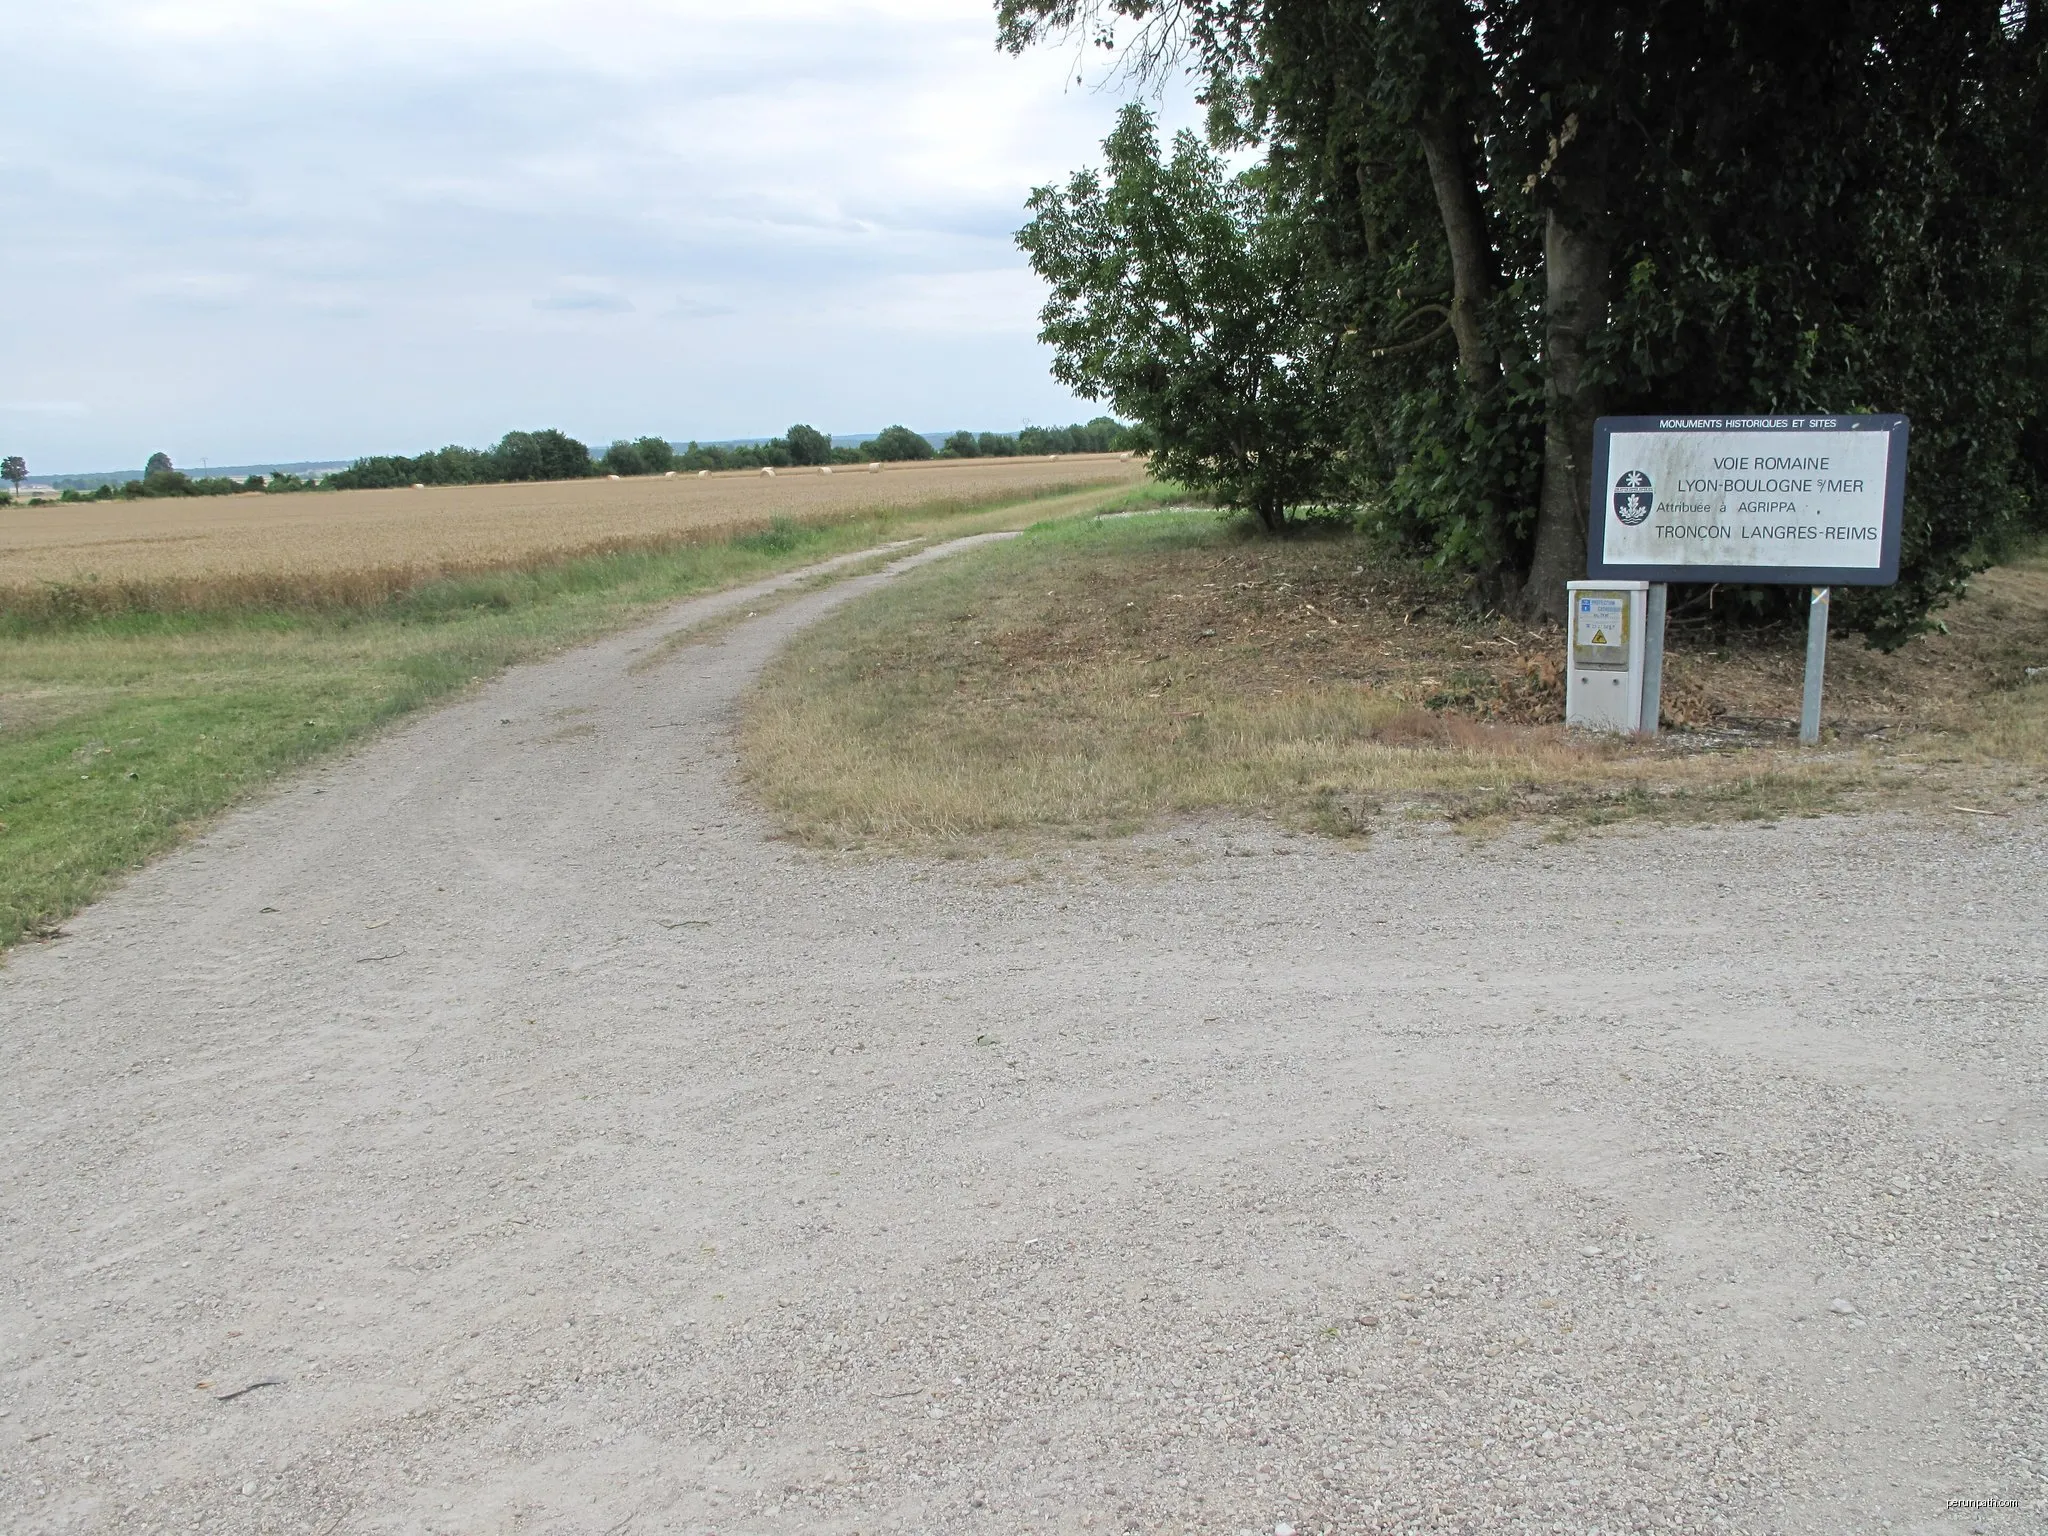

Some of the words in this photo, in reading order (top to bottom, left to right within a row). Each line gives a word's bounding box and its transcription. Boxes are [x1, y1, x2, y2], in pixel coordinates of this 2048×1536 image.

[1660, 419, 1722, 428] MONUMENTS
[1726, 419, 1788, 429] HISTORIQUES
[1791, 419, 1805, 428] ET
[1809, 419, 1837, 428] SITES
[1714, 457, 1749, 470] VOIE
[1754, 457, 1829, 470] ROMAINE
[1678, 479, 1812, 492] LYON-BOULOGNE
[1656, 502, 1711, 513] Attribuée
[1720, 502, 1727, 513] à
[1738, 502, 1796, 513] AGRIPPA
[1742, 526, 1877, 540] LANGRES-REIMS
